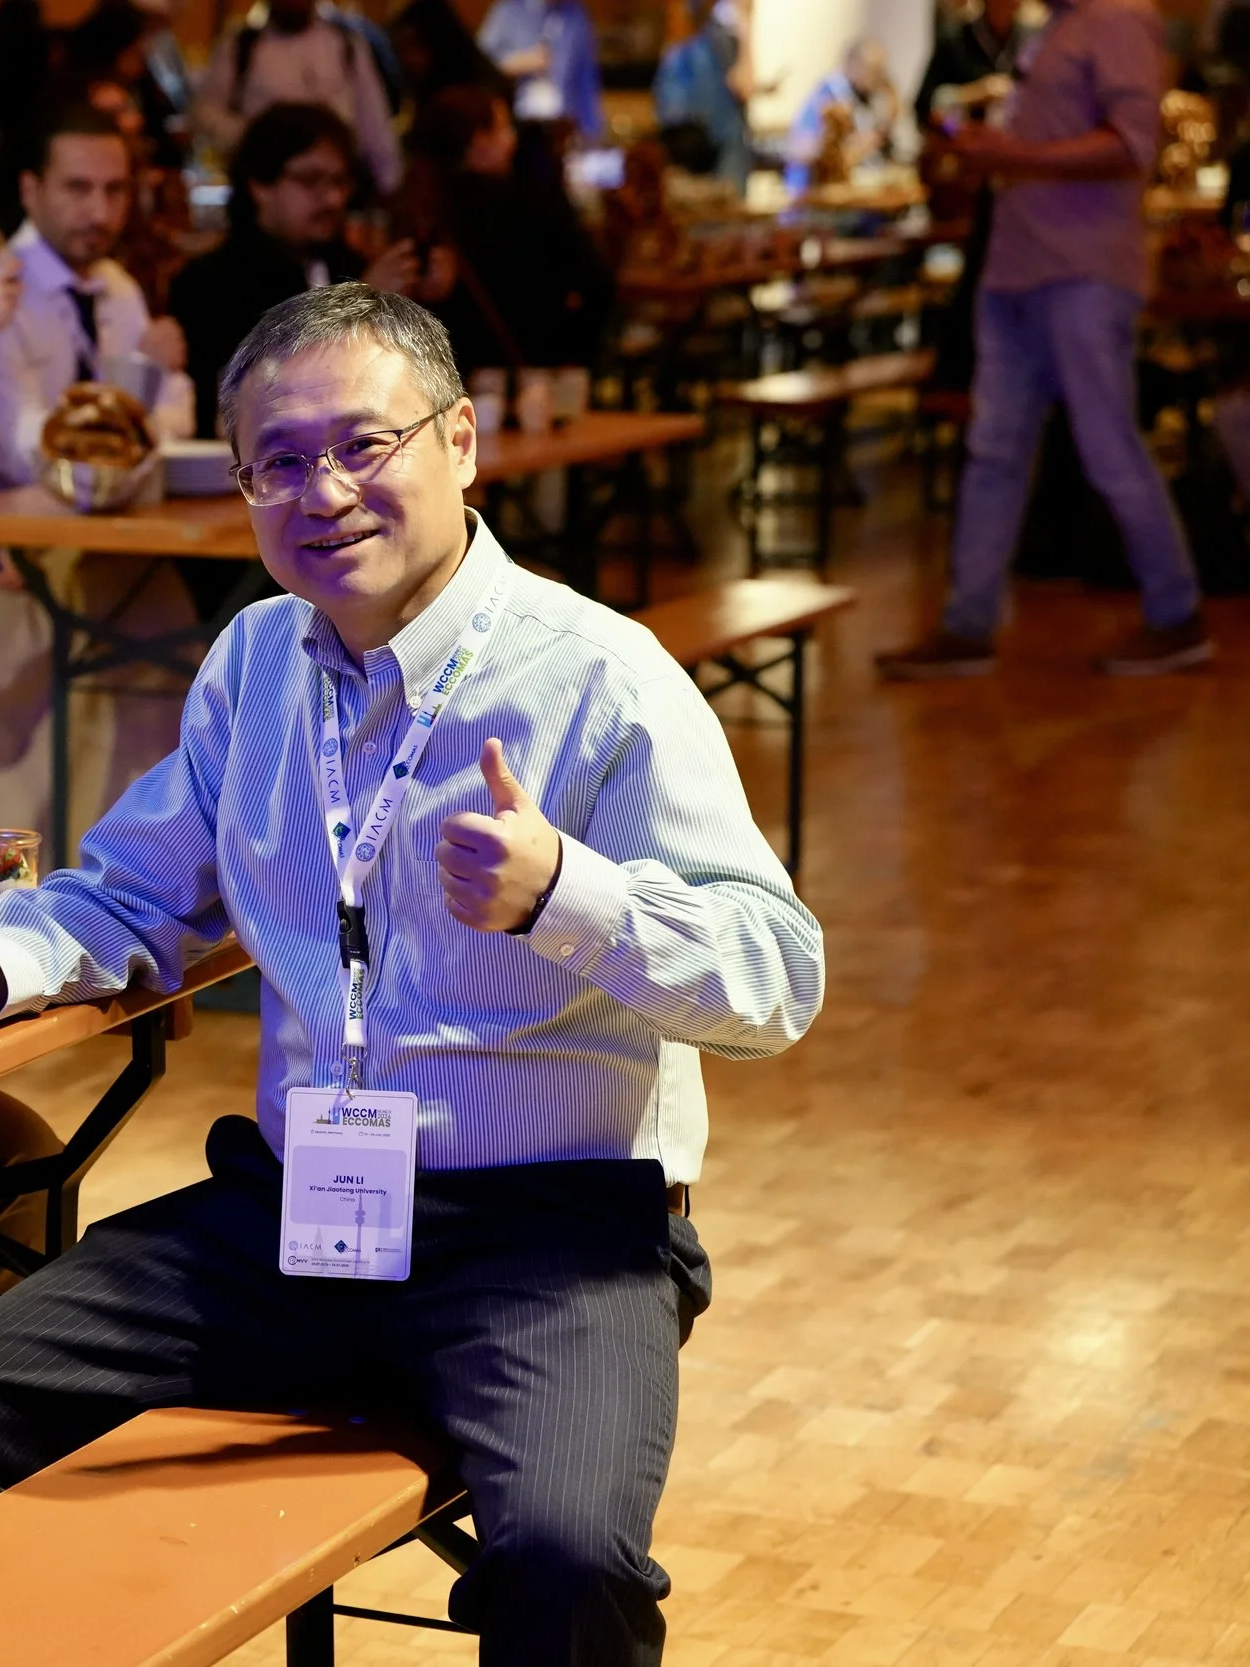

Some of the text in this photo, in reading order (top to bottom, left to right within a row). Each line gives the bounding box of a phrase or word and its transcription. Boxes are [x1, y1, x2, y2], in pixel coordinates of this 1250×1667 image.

[433, 658, 459, 694] WCCM
[441, 650, 474, 696] ECCOMAS
[349, 982, 358, 1020] WCCM
[356, 968, 366, 1020] ECCOMAS
[342, 1107, 377, 1118] WCCM
[342, 1117, 391, 1127] ECCOMAS
[326, 1186, 354, 1195] Jiaotong
[355, 1187, 387, 1196] University
[333, 1175, 364, 1184] JUN LI
